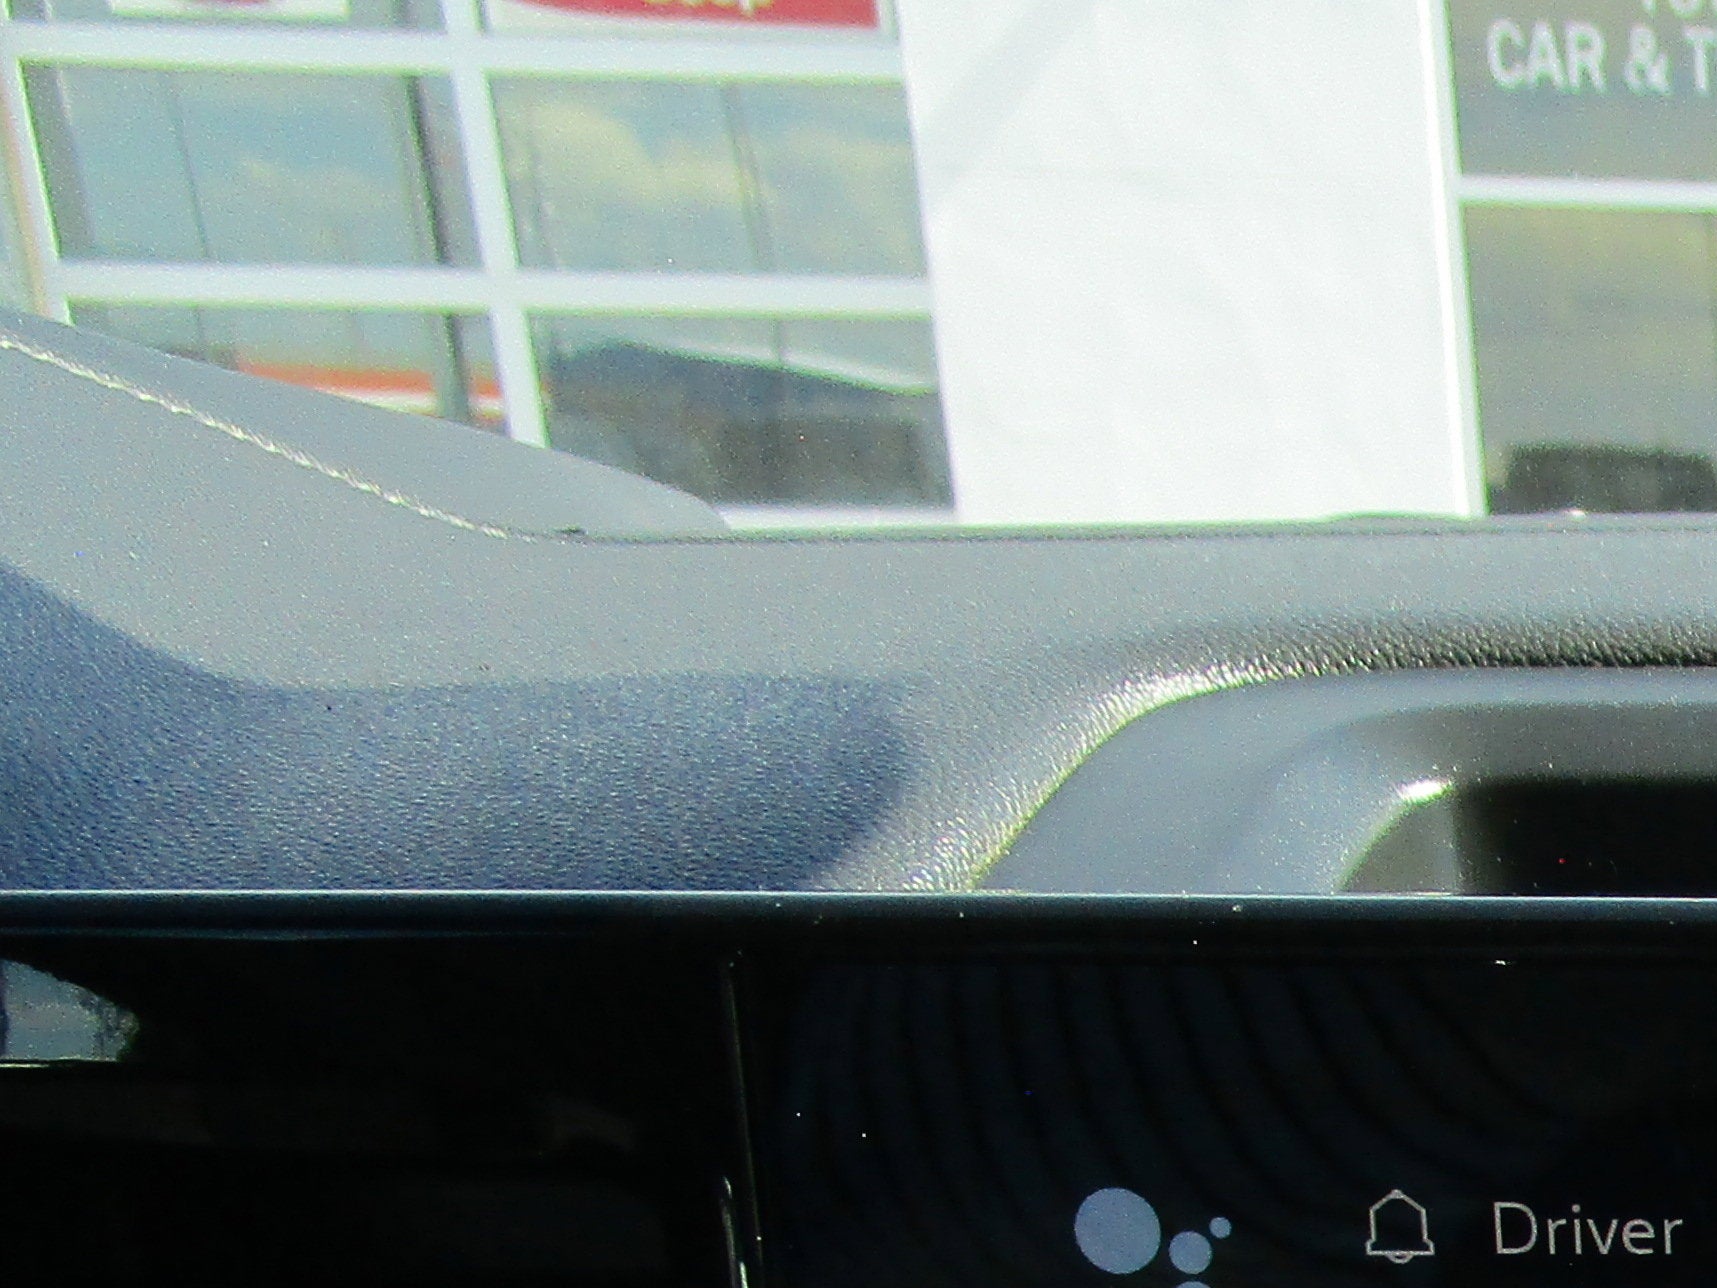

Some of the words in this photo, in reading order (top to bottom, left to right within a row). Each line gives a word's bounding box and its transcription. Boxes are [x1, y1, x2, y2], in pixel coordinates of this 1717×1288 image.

[1486, 18, 1605, 92] CAR
[1622, 22, 1672, 95] &
[1493, 1202, 1683, 1255] Driver
